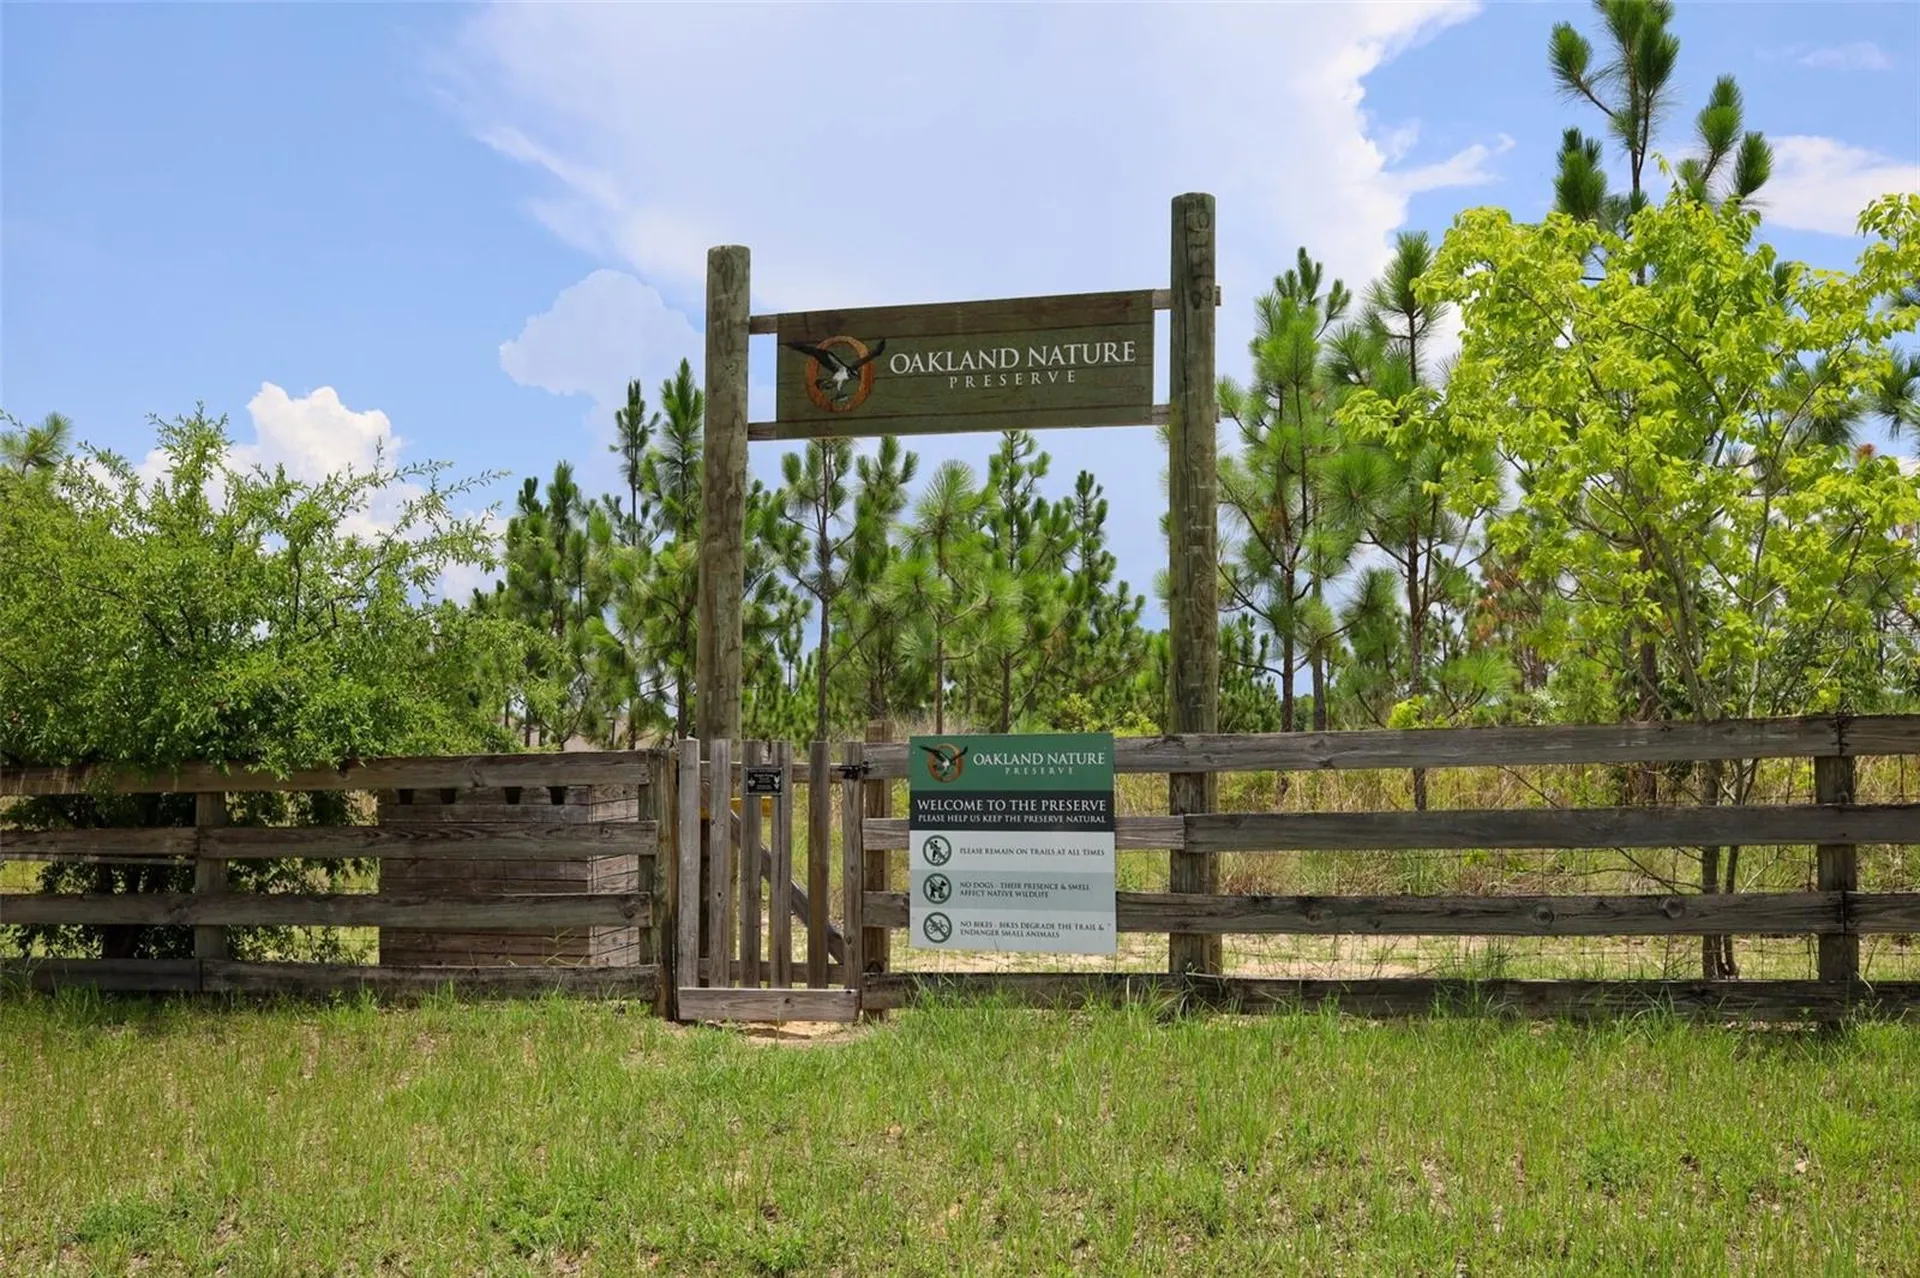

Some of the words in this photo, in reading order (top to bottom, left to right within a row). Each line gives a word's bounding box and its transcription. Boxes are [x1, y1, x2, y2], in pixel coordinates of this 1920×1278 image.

[890, 348, 1020, 375] OAKLAND
[1027, 341, 1136, 367] NATURE
[950, 370, 1076, 389] PRESERVE
[973, 753, 1043, 766] OAKLAND
[1047, 752, 1105, 765] NATURE
[1005, 767, 1073, 775] PRESERVE
[917, 800, 983, 811] WELCOME
[987, 800, 1006, 811] TO
[1010, 800, 1037, 811] THE
[1041, 800, 1106, 812] PRESERVE
[918, 815, 945, 823] PLEASE
[947, 815, 968, 823] HELP
[969, 815, 981, 823] US
[983, 815, 1003, 823] KEEP
[1004, 815, 1021, 823] THE
[1024, 815, 1064, 823] PRESERVE
[1066, 815, 1106, 823] NATURAL
[1023, 882, 1059, 890] PRESENCE
[1020, 922, 1055, 930] DEGRADE
[1074, 923, 1096, 931] TRAIL
